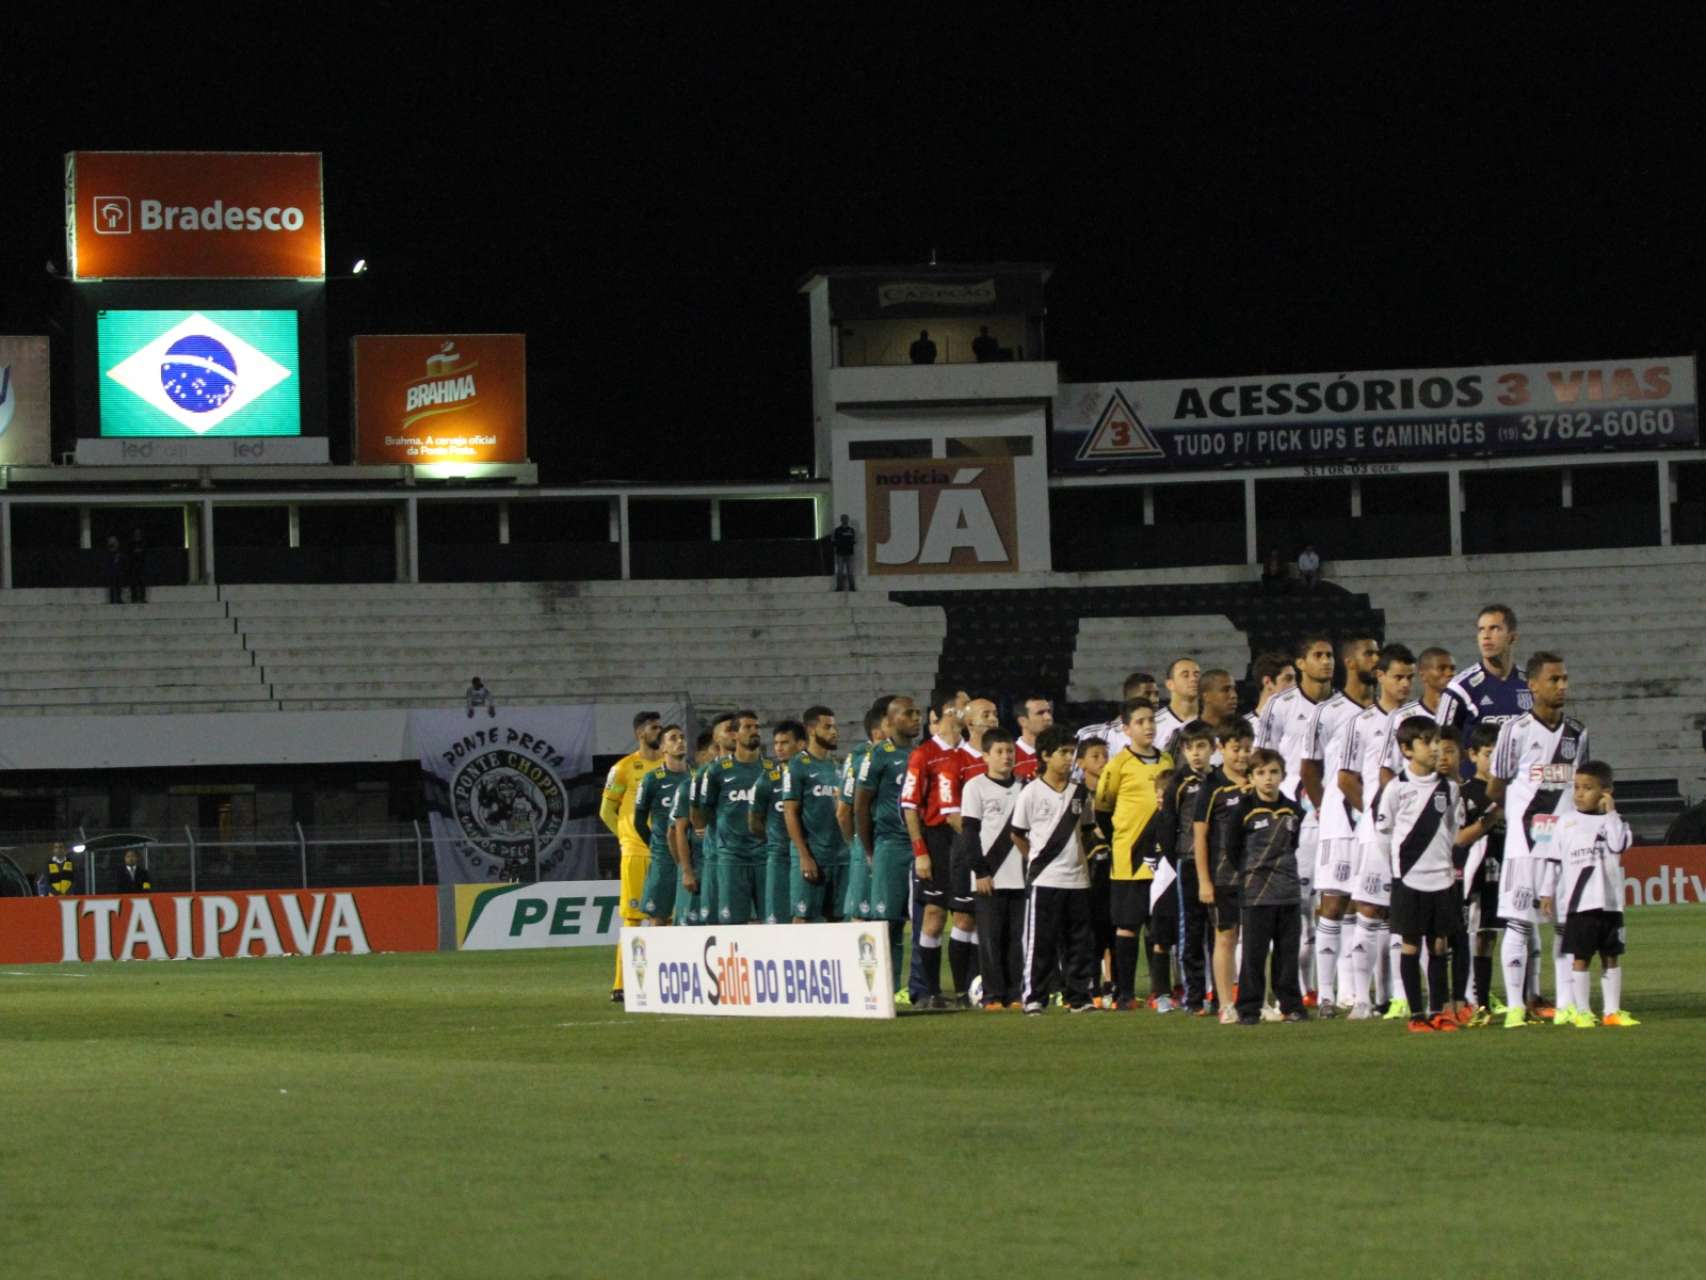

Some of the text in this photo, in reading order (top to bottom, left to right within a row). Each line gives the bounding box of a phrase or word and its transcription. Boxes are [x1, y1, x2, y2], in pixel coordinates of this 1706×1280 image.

[140, 199, 304, 231] Bradesco
[406, 374, 476, 412] BRAHMA
[1173, 366, 1671, 420] ACESSÓRIOS 3 VIAS
[1110, 421, 1131, 446] 3
[1173, 433, 1226, 456] TUDO
[1257, 429, 1303, 451] PICK
[1309, 426, 1347, 450] UPS
[1354, 426, 1365, 448] E
[1371, 418, 1486, 447] CAMINHÕES
[1521, 408, 1675, 440] 3782-6060
[875, 468, 1009, 565] JÁ
[443, 727, 564, 767] PONTE PRETA
[456, 752, 500, 798] PONTE
[60, 891, 371, 961] ITAIPAVA
[509, 896, 621, 937] PET
[658, 935, 849, 1006] COPA Sadia DO BRASIL
